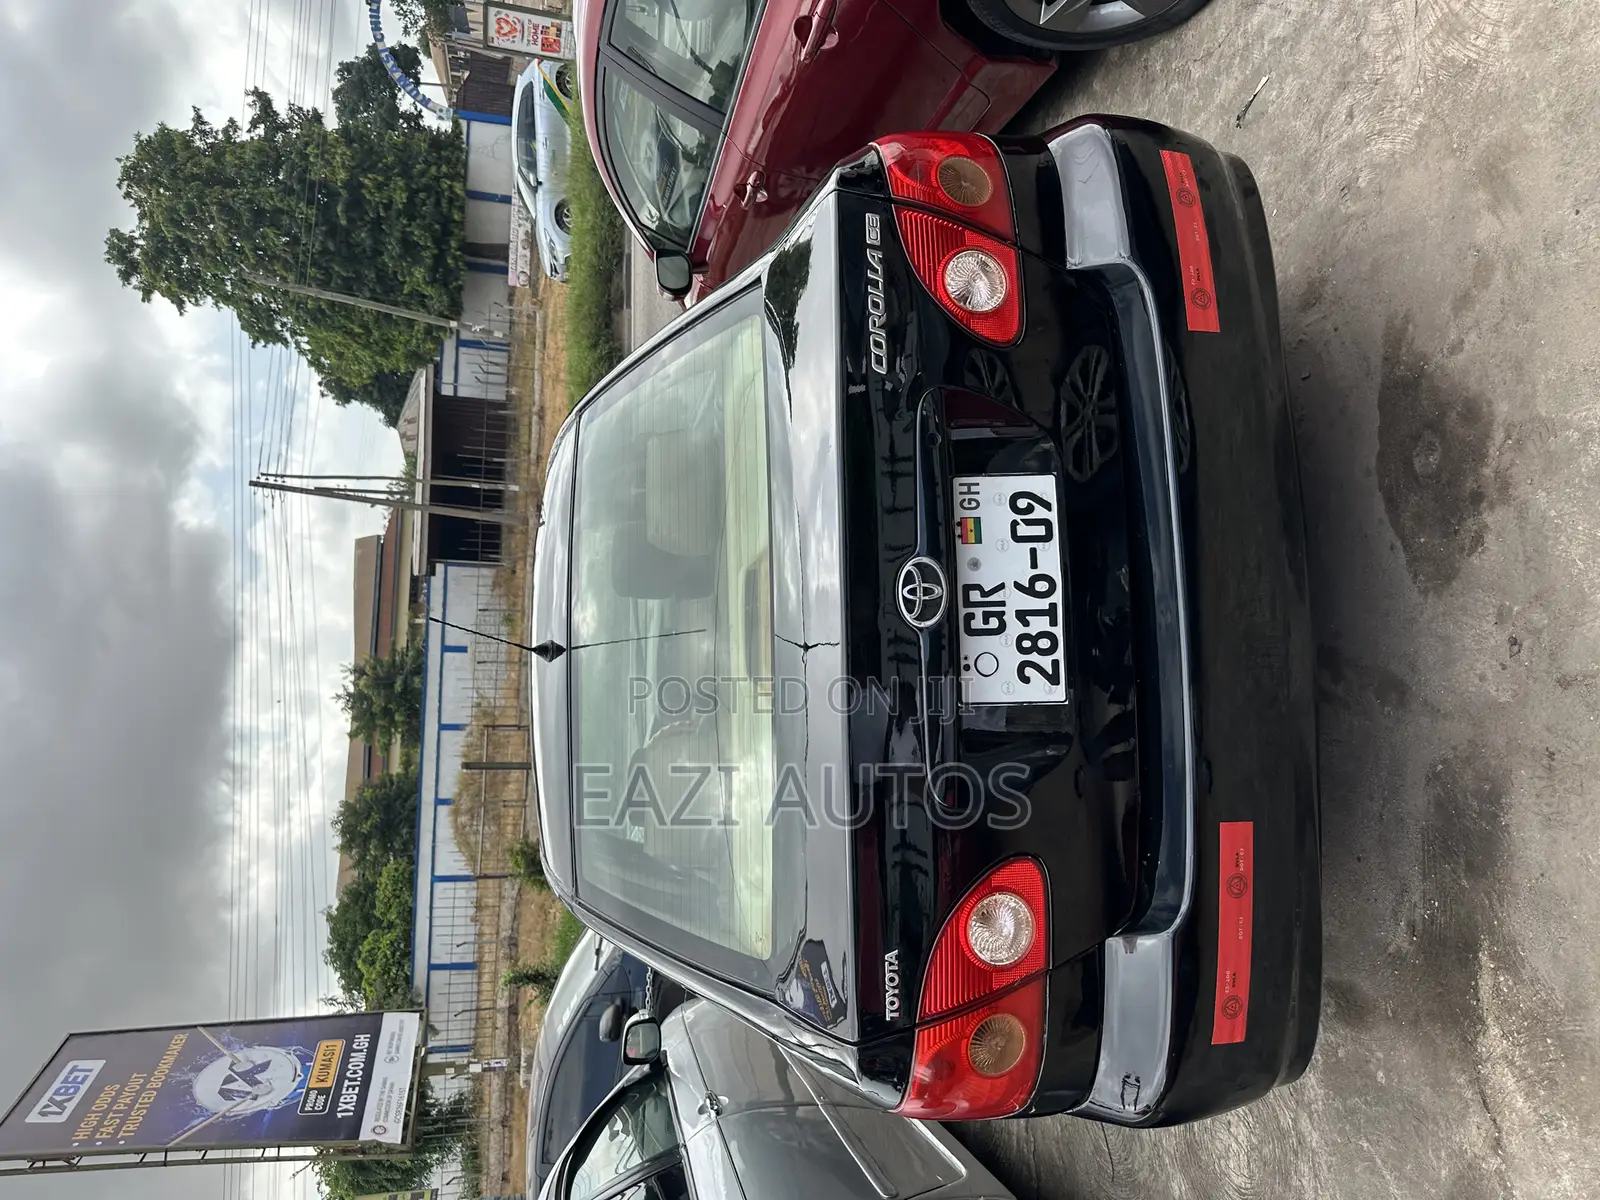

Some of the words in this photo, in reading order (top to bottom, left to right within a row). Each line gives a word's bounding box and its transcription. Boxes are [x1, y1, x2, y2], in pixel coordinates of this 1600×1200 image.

[531, 23, 539, 46] HOME
[377, 47, 432, 108] KUMASI
[866, 214, 880, 244] CE
[866, 248, 888, 374] COROLLA
[958, 482, 981, 511] GH
[962, 582, 1006, 636] GR
[1008, 491, 1060, 686] 2816-09
[884, 949, 900, 1021] TOYOTA
[38, 1064, 94, 1117] 1XBET
[118, 1090, 158, 1138] TRUSTED
[146, 1032, 190, 1088] BOOKMAKER
[316, 1044, 337, 1083] KUMASI1
[337, 1034, 371, 1118] 1XBET.COM.GH
[72, 1113, 103, 1140] HIGH
[92, 1084, 120, 1110] ODDS
[95, 1112, 124, 1139] FAST
[112, 1072, 148, 1110] PAYOUT
[304, 1090, 318, 1111] PROMO
[315, 1094, 326, 1110] CODE
